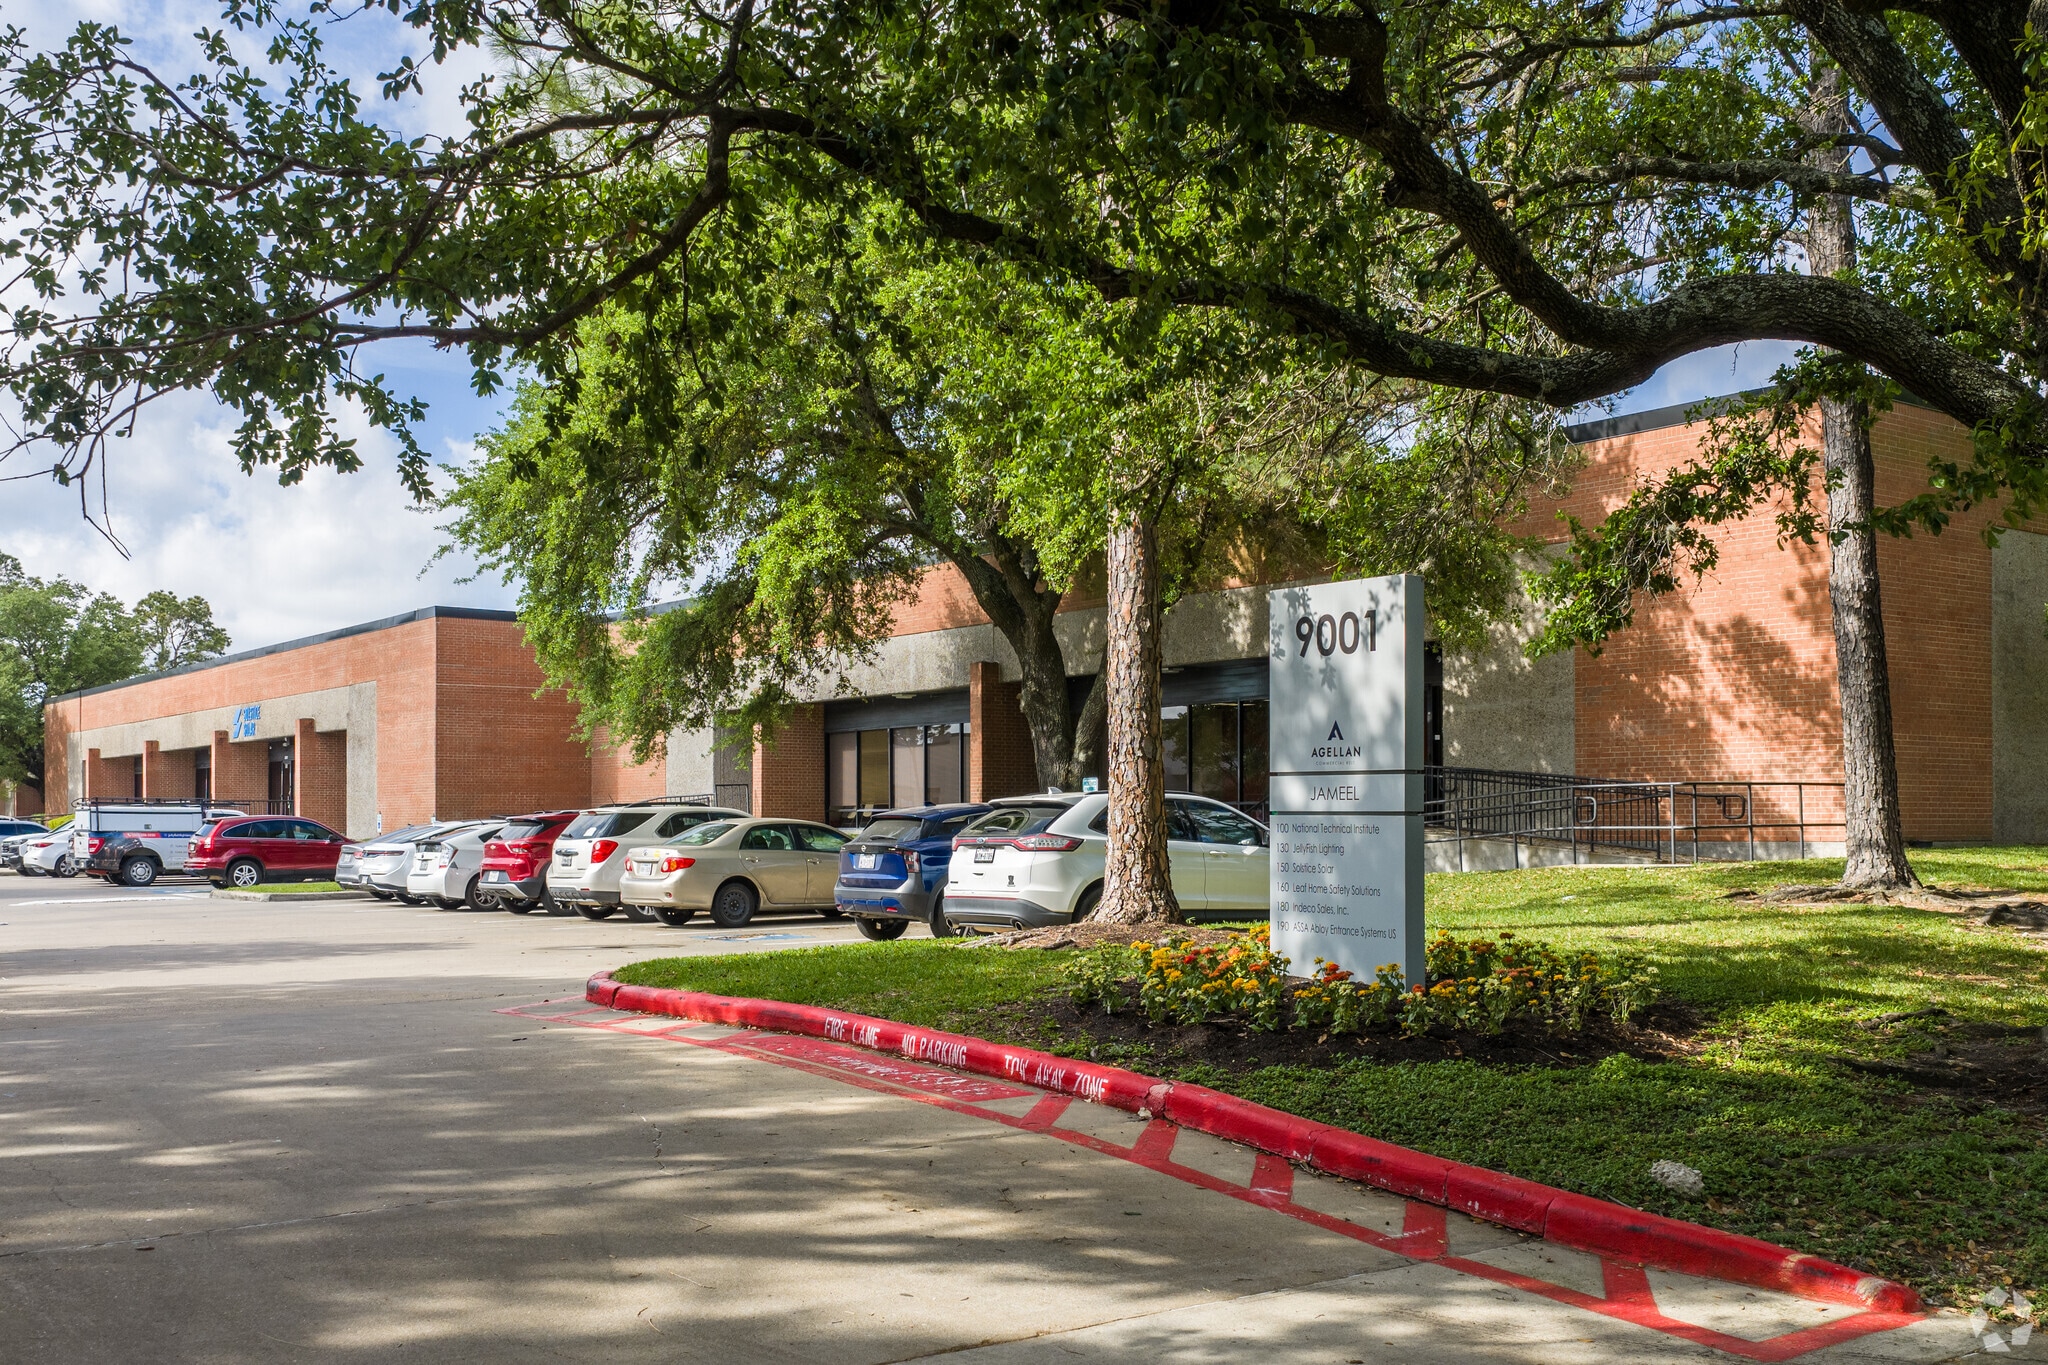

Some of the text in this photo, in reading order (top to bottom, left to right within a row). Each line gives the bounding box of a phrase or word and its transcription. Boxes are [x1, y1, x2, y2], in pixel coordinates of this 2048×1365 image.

[1296, 609, 1377, 658] 9001
[1311, 746, 1361, 757] AGELLAN
[1311, 786, 1360, 801] JAMEEL
[1277, 823, 1380, 834] 100 National Technical Institute
[1277, 843, 1344, 856] 130 JellyFish Lighting
[1277, 862, 1334, 873] 150 Solstice Solar
[1277, 882, 1381, 896] 160 Leaf Home Safety Solutions
[1277, 901, 1349, 915] 180 Indeco Sales, Inc.
[1277, 921, 1396, 939] 190 ASSA Abloy Entrance Systems US
[824, 1016, 880, 1049] FIRE LANE
[902, 1033, 916, 1057] NO
[919, 1037, 967, 1067] PARKING
[1004, 1054, 1109, 1101] TOW AWAY ZONE
